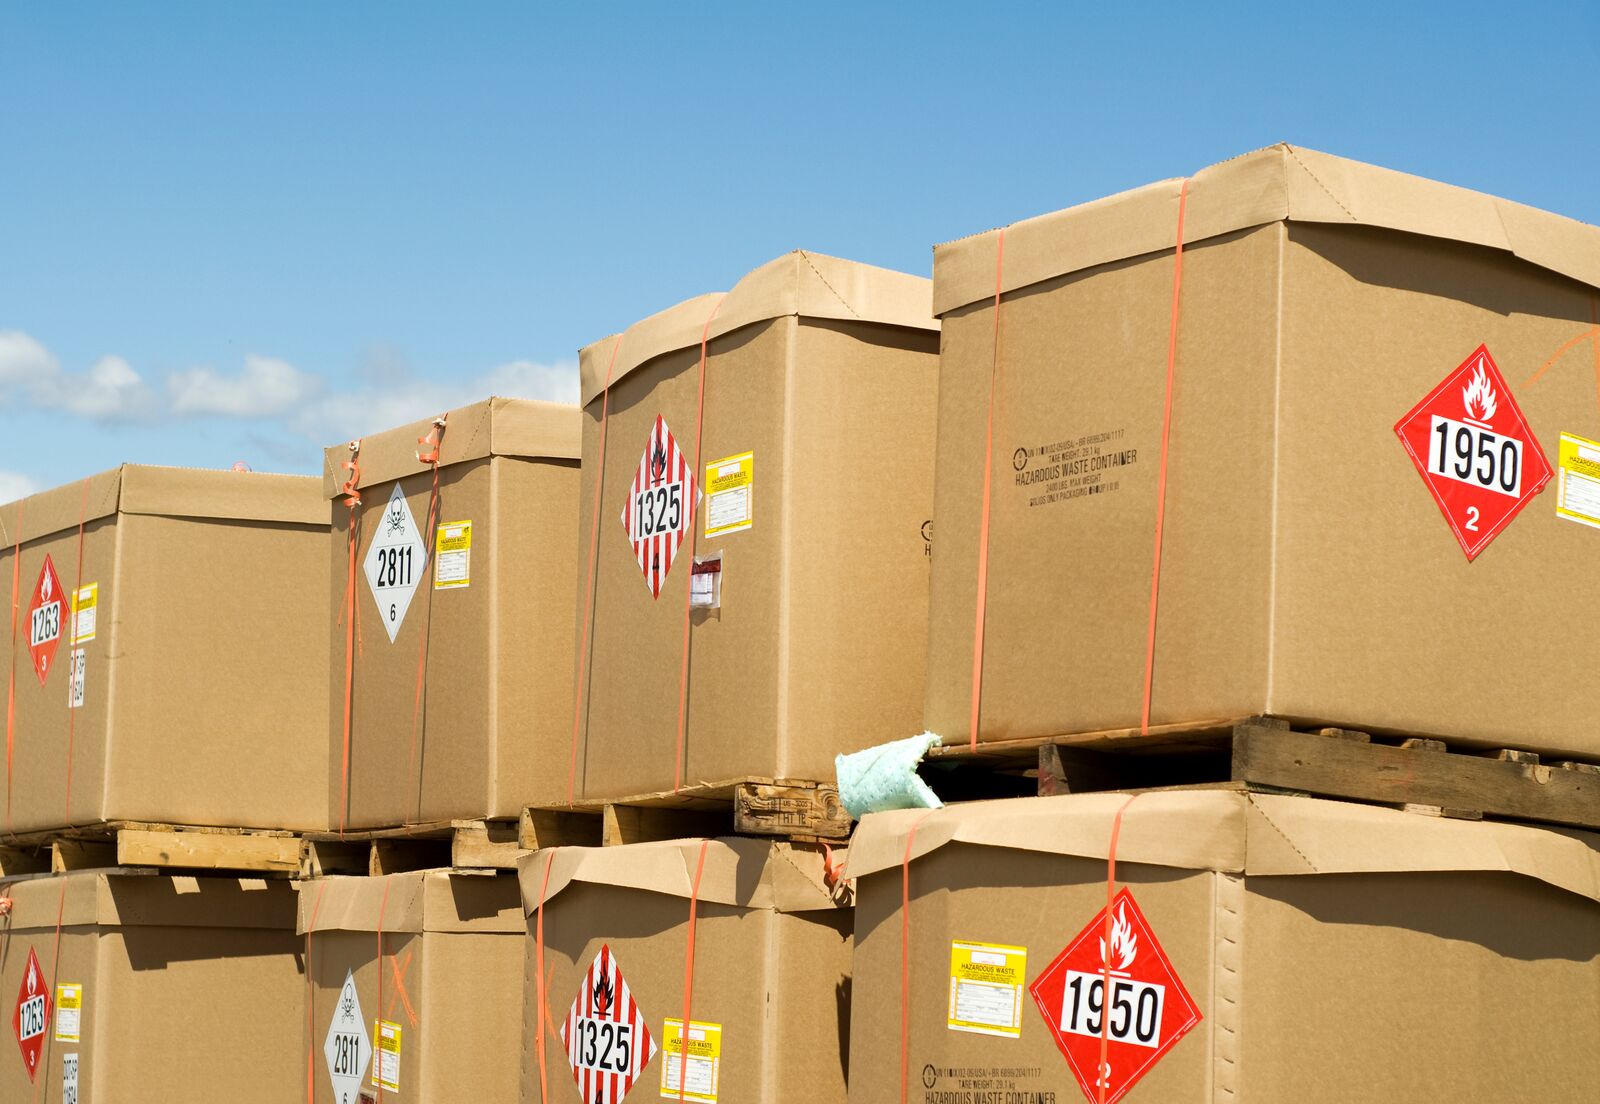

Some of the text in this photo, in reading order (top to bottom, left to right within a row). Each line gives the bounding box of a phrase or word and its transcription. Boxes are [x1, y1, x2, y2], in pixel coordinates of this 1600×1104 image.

[1015, 449, 1138, 487] HAZARDOUS WASTE CONTAINER
[1436, 422, 1518, 492] 1950
[638, 484, 680, 538] 1325
[1465, 506, 1480, 532] 2
[377, 545, 412, 588] 2811
[652, 552, 660, 571] 4
[33, 603, 59, 644] 1263
[390, 603, 396, 622] 6
[41, 655, 47, 672] 3
[961, 963, 1015, 975] HAZARDOUS WASTE
[21, 998, 43, 1038] 1263
[1070, 976, 1159, 1043] 1950
[29, 1049, 35, 1067] 3
[334, 1034, 359, 1075] 2811
[578, 1018, 630, 1073] 1325
[670, 1038, 697, 1047] HAZAOUS
[925, 1091, 1056, 1104] HAZARDOUS WASTE CONTAINER
[958, 1079, 972, 1090] TARE
